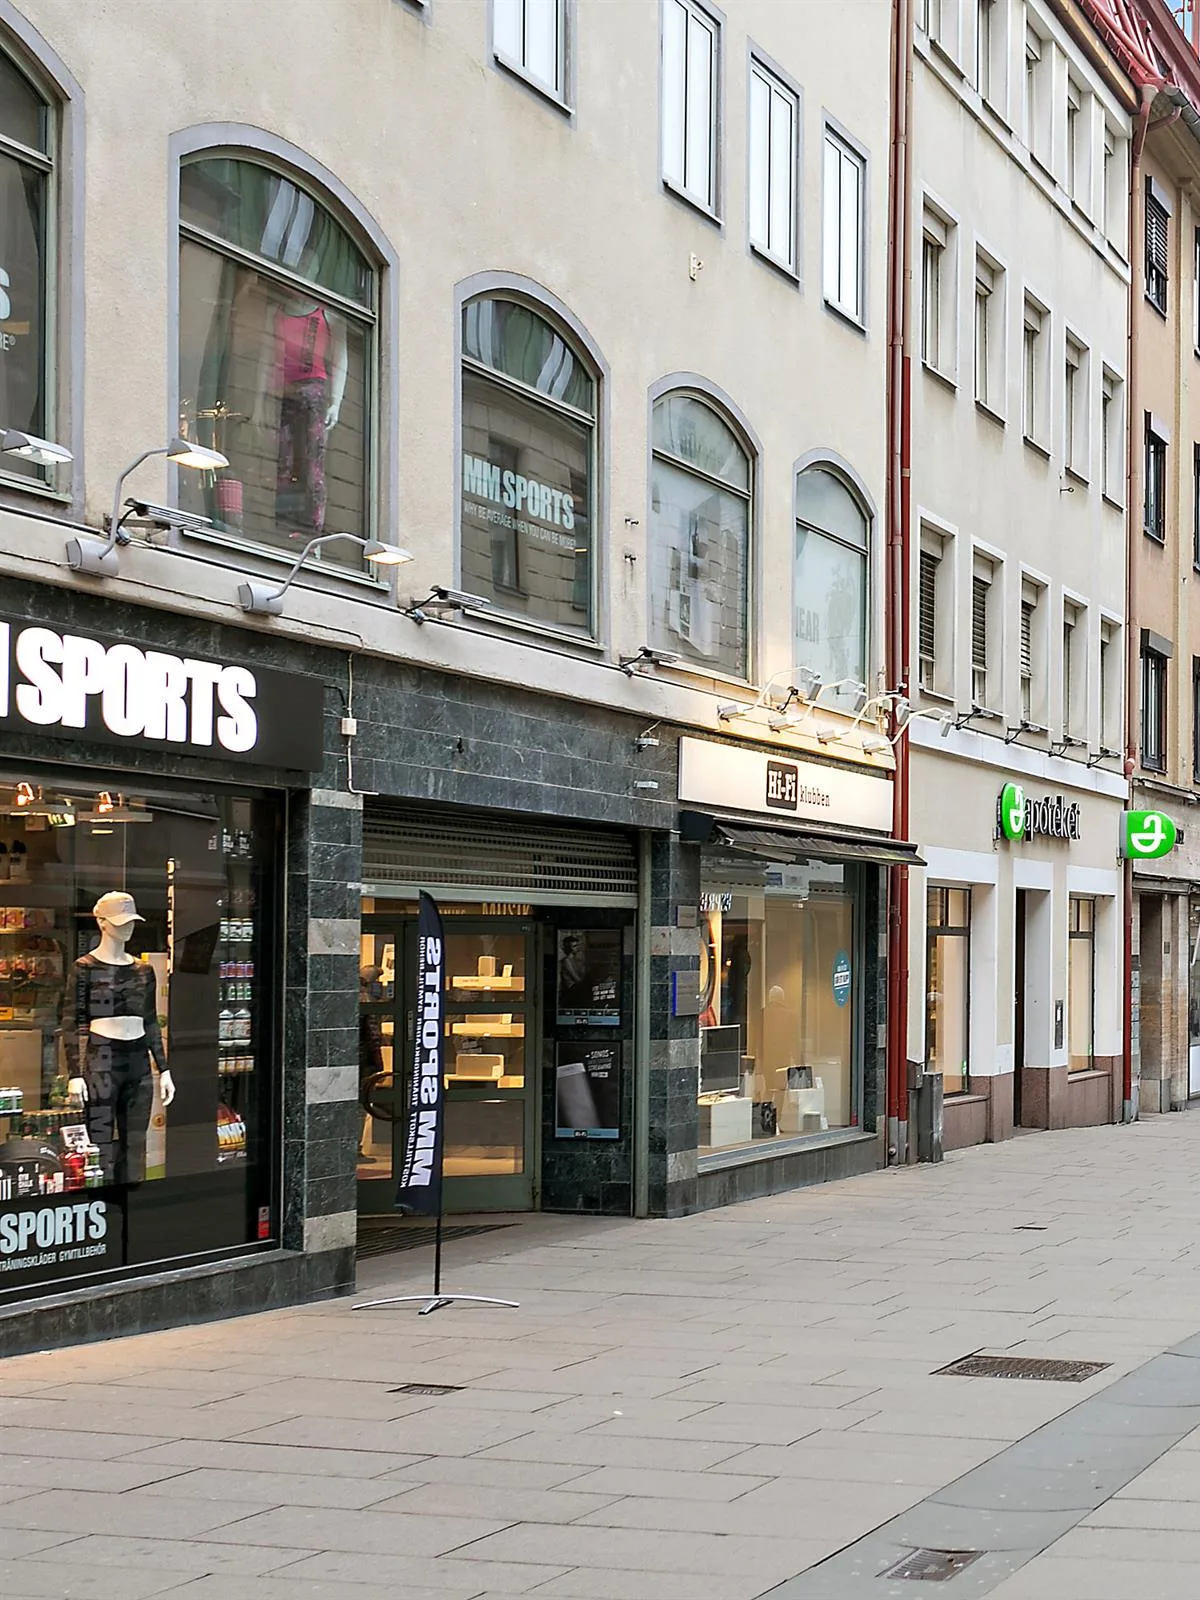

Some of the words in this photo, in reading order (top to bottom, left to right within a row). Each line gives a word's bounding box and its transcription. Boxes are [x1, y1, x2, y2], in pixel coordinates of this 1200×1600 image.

[463, 453, 501, 503] MM
[502, 469, 575, 530] SPORTS
[16, 627, 258, 752] SPORTS
[768, 770, 796, 802] Hi-Fi
[800, 785, 830, 807] klubben
[1024, 797, 1081, 842] apoteket
[0, 1201, 107, 1254] SPORTS
[58, 1243, 107, 1263] GYMTILLBEHÖR
